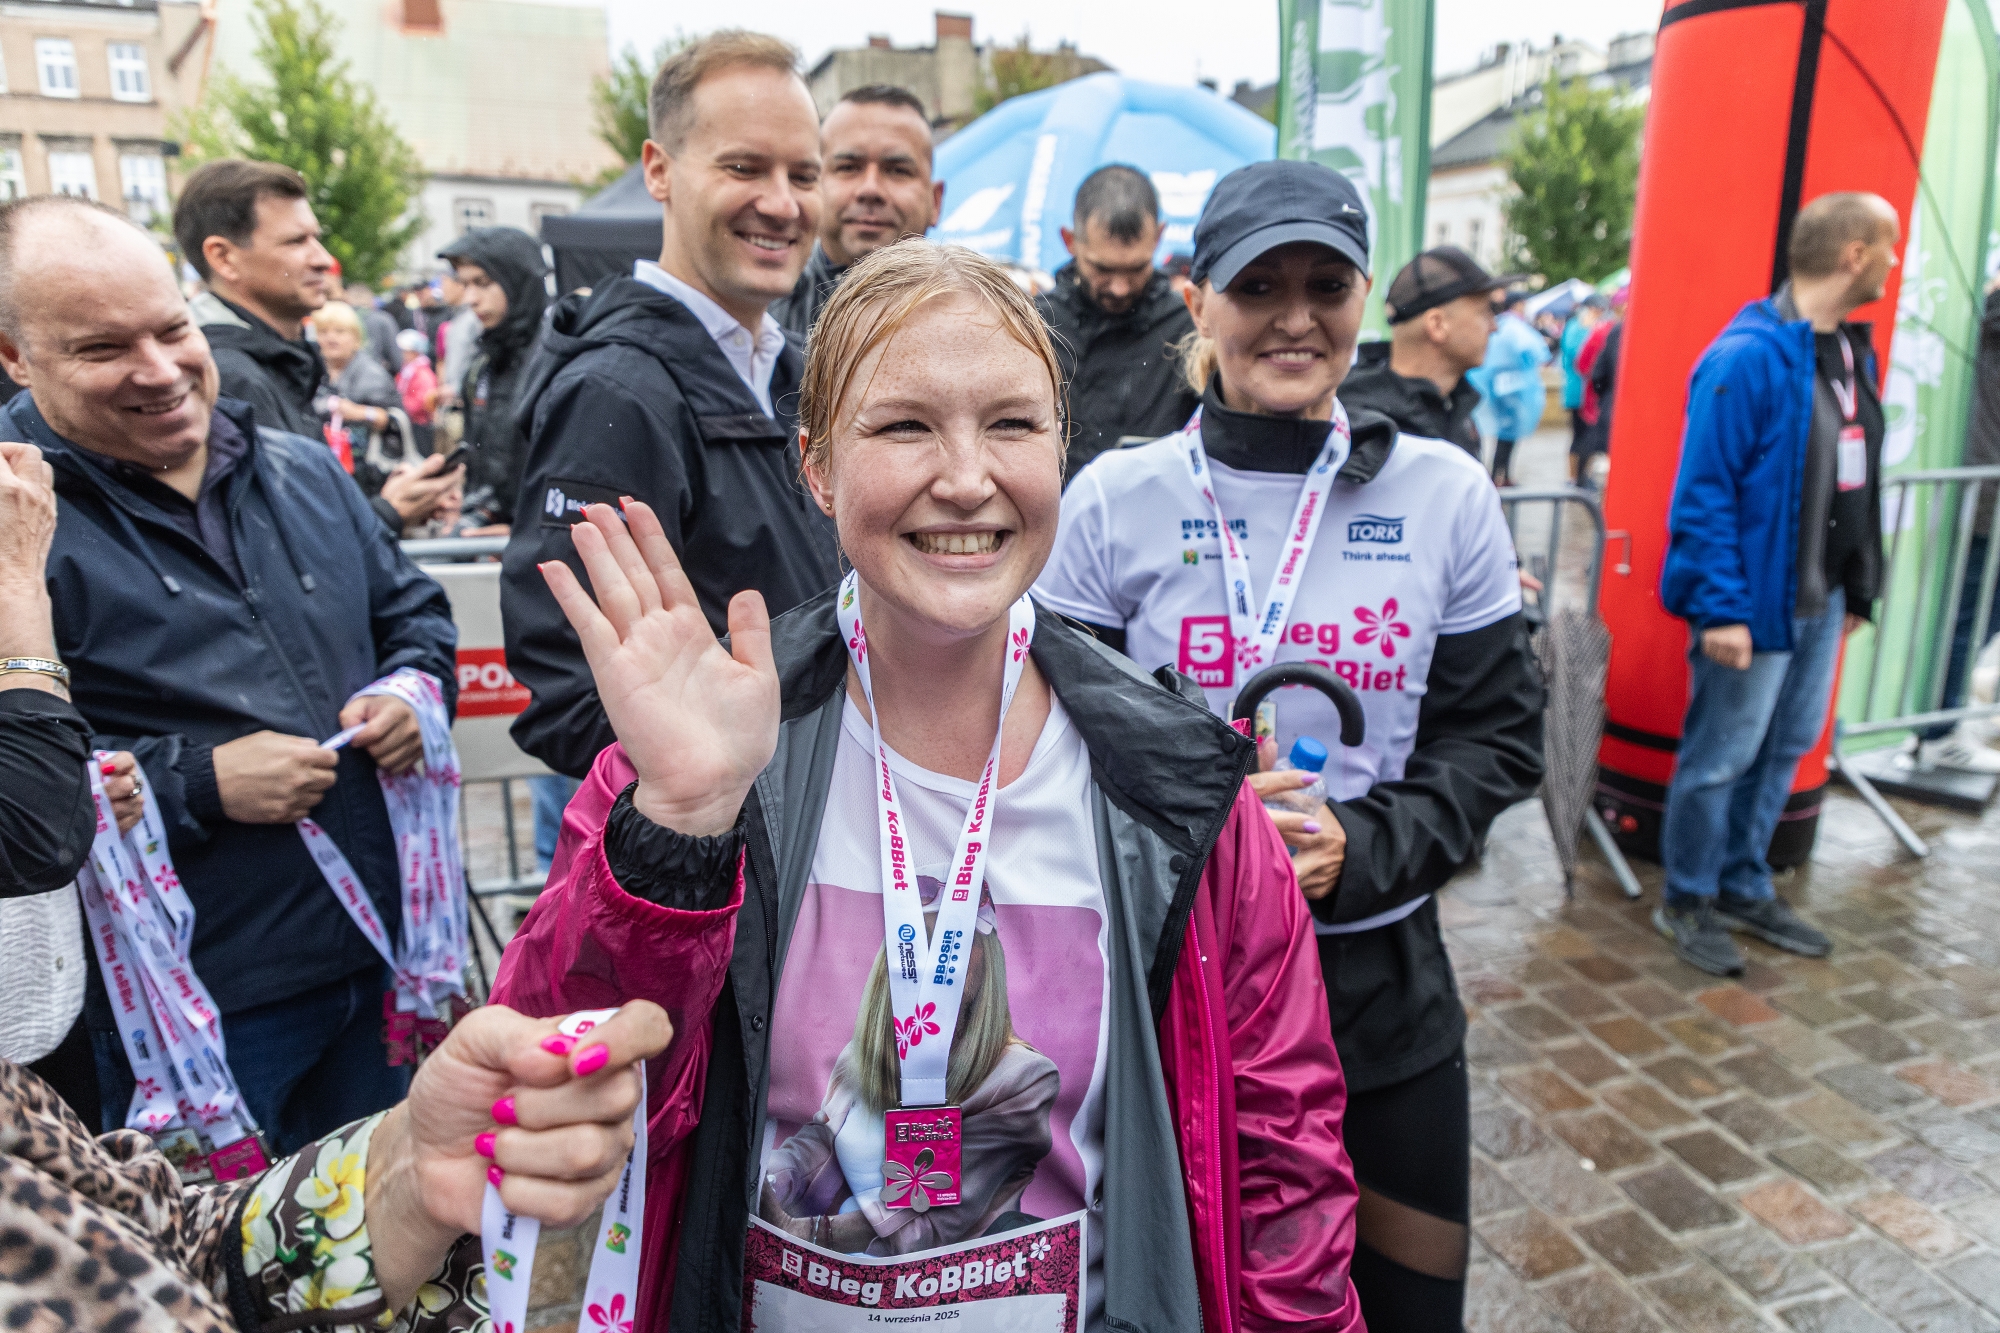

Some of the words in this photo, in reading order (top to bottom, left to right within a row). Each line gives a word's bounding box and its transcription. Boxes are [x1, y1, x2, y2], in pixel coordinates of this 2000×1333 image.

[1182, 519, 1247, 531] BBOiR
[1351, 524, 1400, 541] TORK
[1342, 551, 1372, 561] Think
[1188, 622, 1226, 664] 5
[881, 760, 893, 803] Bieg
[967, 757, 995, 834] KoBBiet
[886, 810, 909, 891] KoBBiet
[955, 841, 982, 886] Bieg
[933, 930, 954, 985] BBOSiR
[786, 1252, 798, 1267] 5
[807, 1260, 883, 1305] Bieg
[894, 1252, 1027, 1299] KoBBiet
[867, 1314, 881, 1322] 14
[885, 1313, 931, 1323] września
[934, 1310, 960, 1321] 2025
